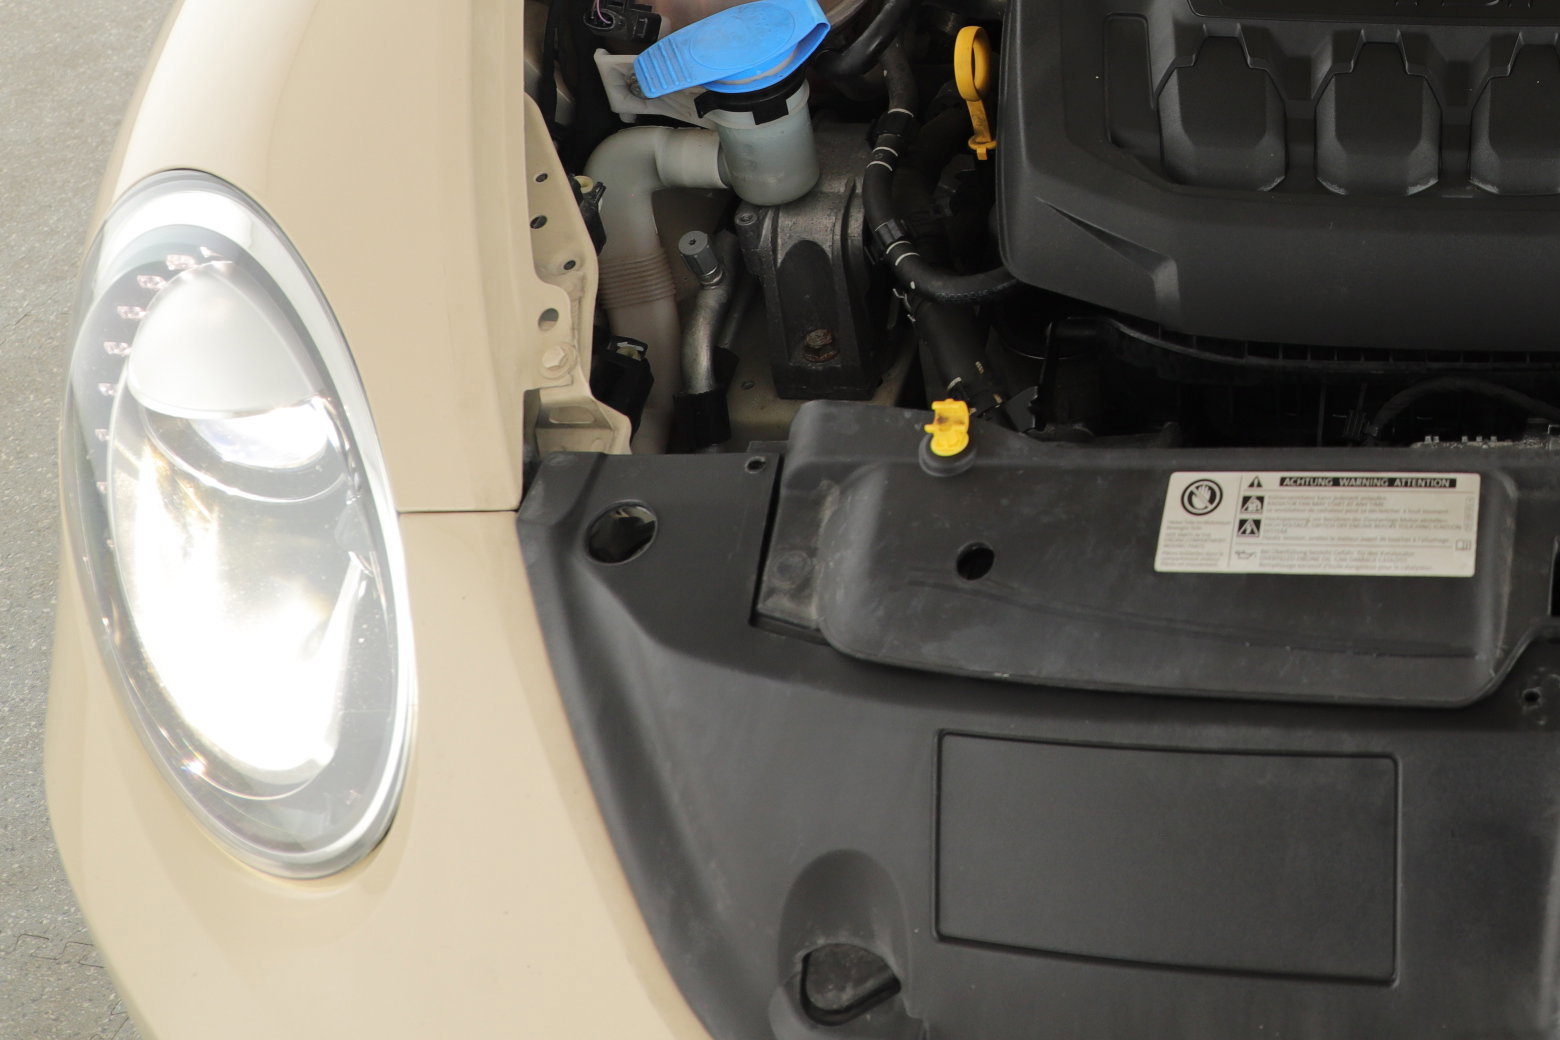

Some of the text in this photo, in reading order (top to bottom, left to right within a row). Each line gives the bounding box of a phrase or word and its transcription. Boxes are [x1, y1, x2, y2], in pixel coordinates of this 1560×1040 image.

[1283, 477, 1451, 488] ACHTUNG WARNING ATTENTION
